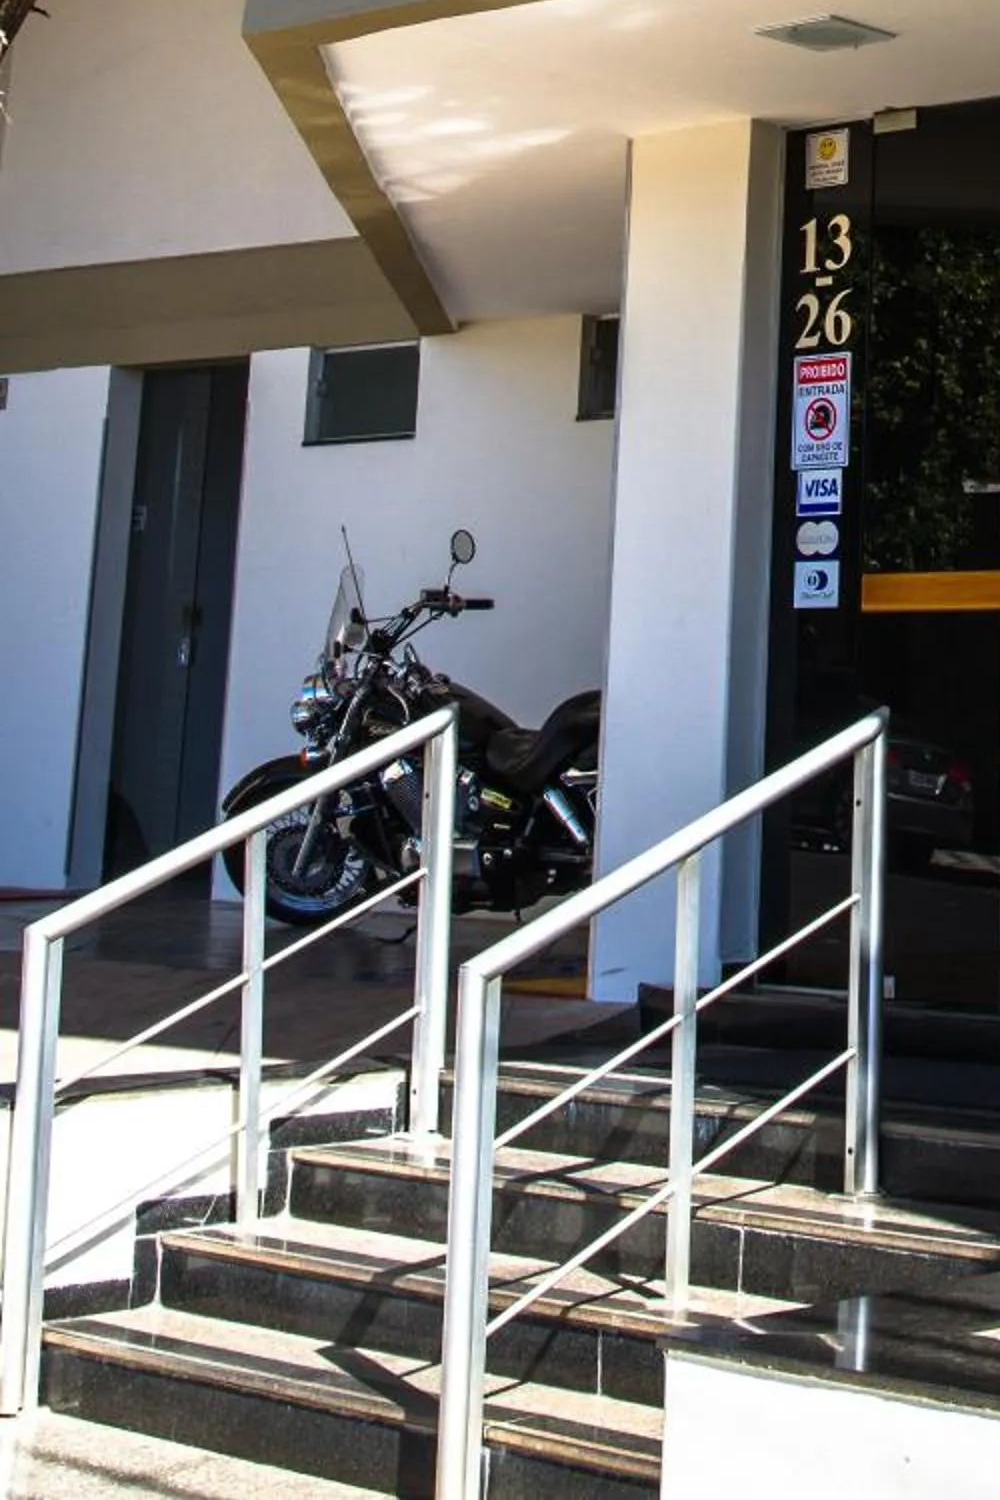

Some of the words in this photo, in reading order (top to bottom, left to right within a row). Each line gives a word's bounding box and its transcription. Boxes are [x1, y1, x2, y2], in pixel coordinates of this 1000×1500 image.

[799, 213, 852, 273] 13
[794, 288, 854, 349] 26
[799, 383, 845, 397] ENTRADA
[805, 478, 838, 497] VISA
